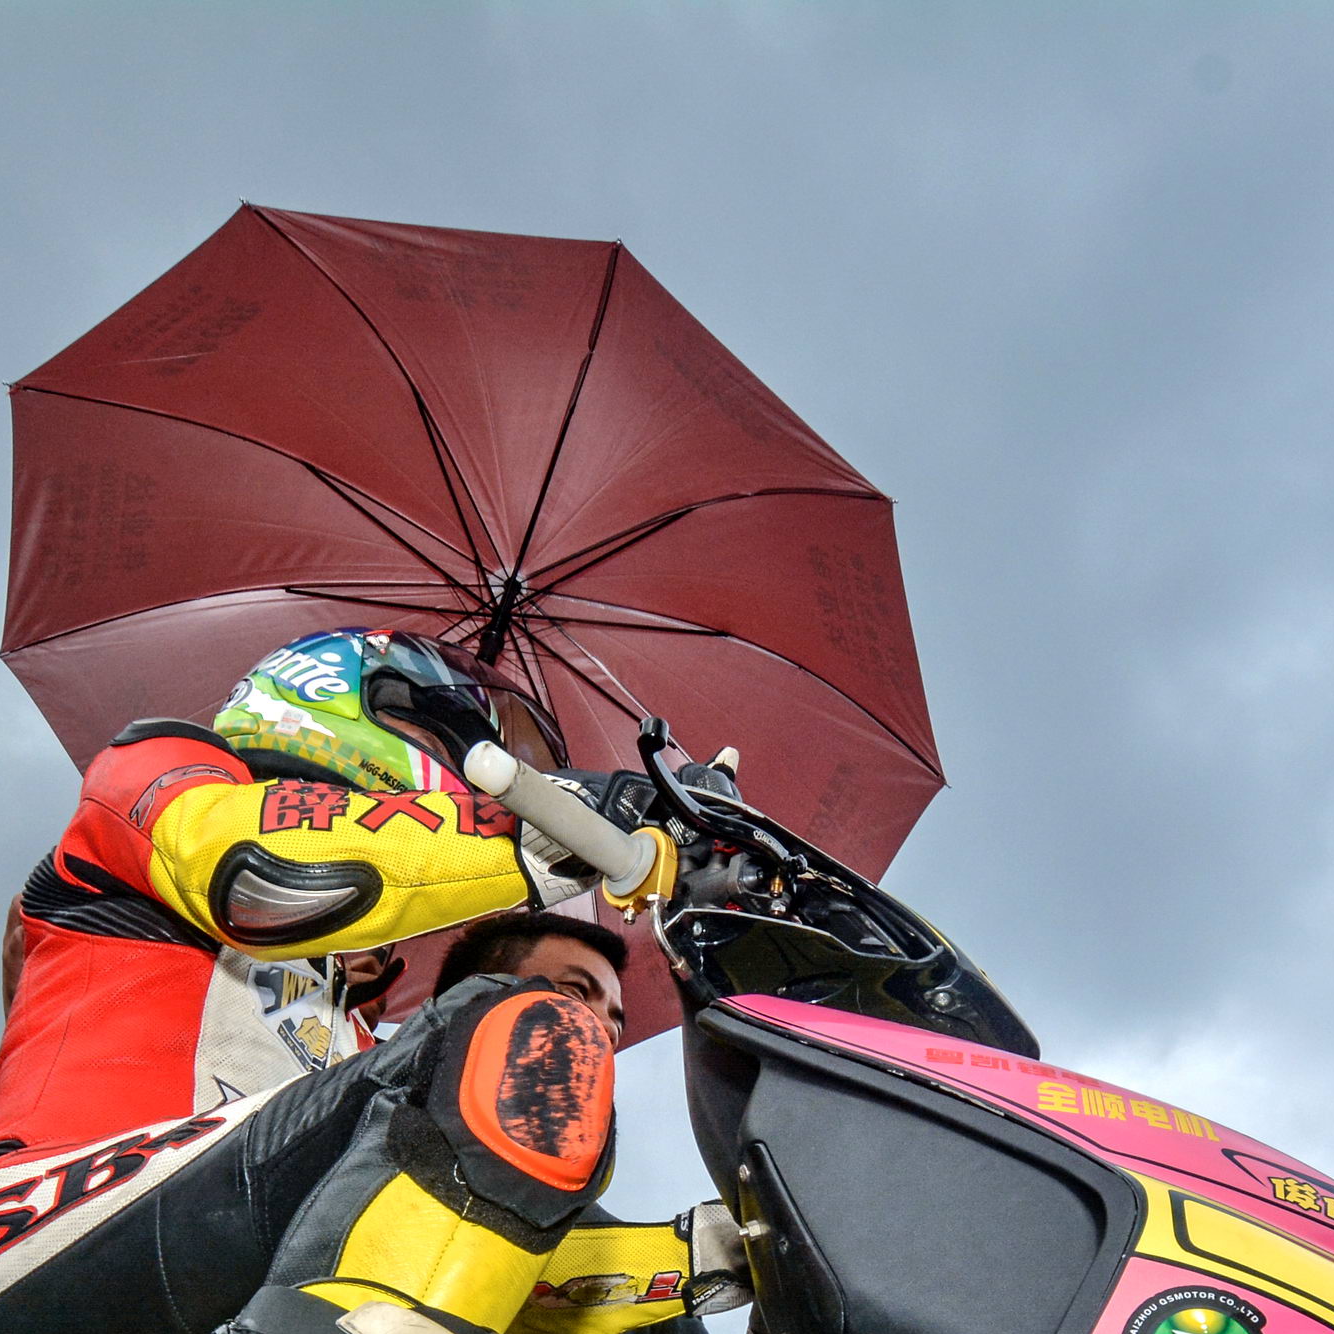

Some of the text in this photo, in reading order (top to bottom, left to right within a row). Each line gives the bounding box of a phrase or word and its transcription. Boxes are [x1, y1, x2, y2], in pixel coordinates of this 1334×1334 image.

[1037, 1081, 1221, 1142] 全顺电机
[1159, 1290, 1216, 1306] QSMOTOR
